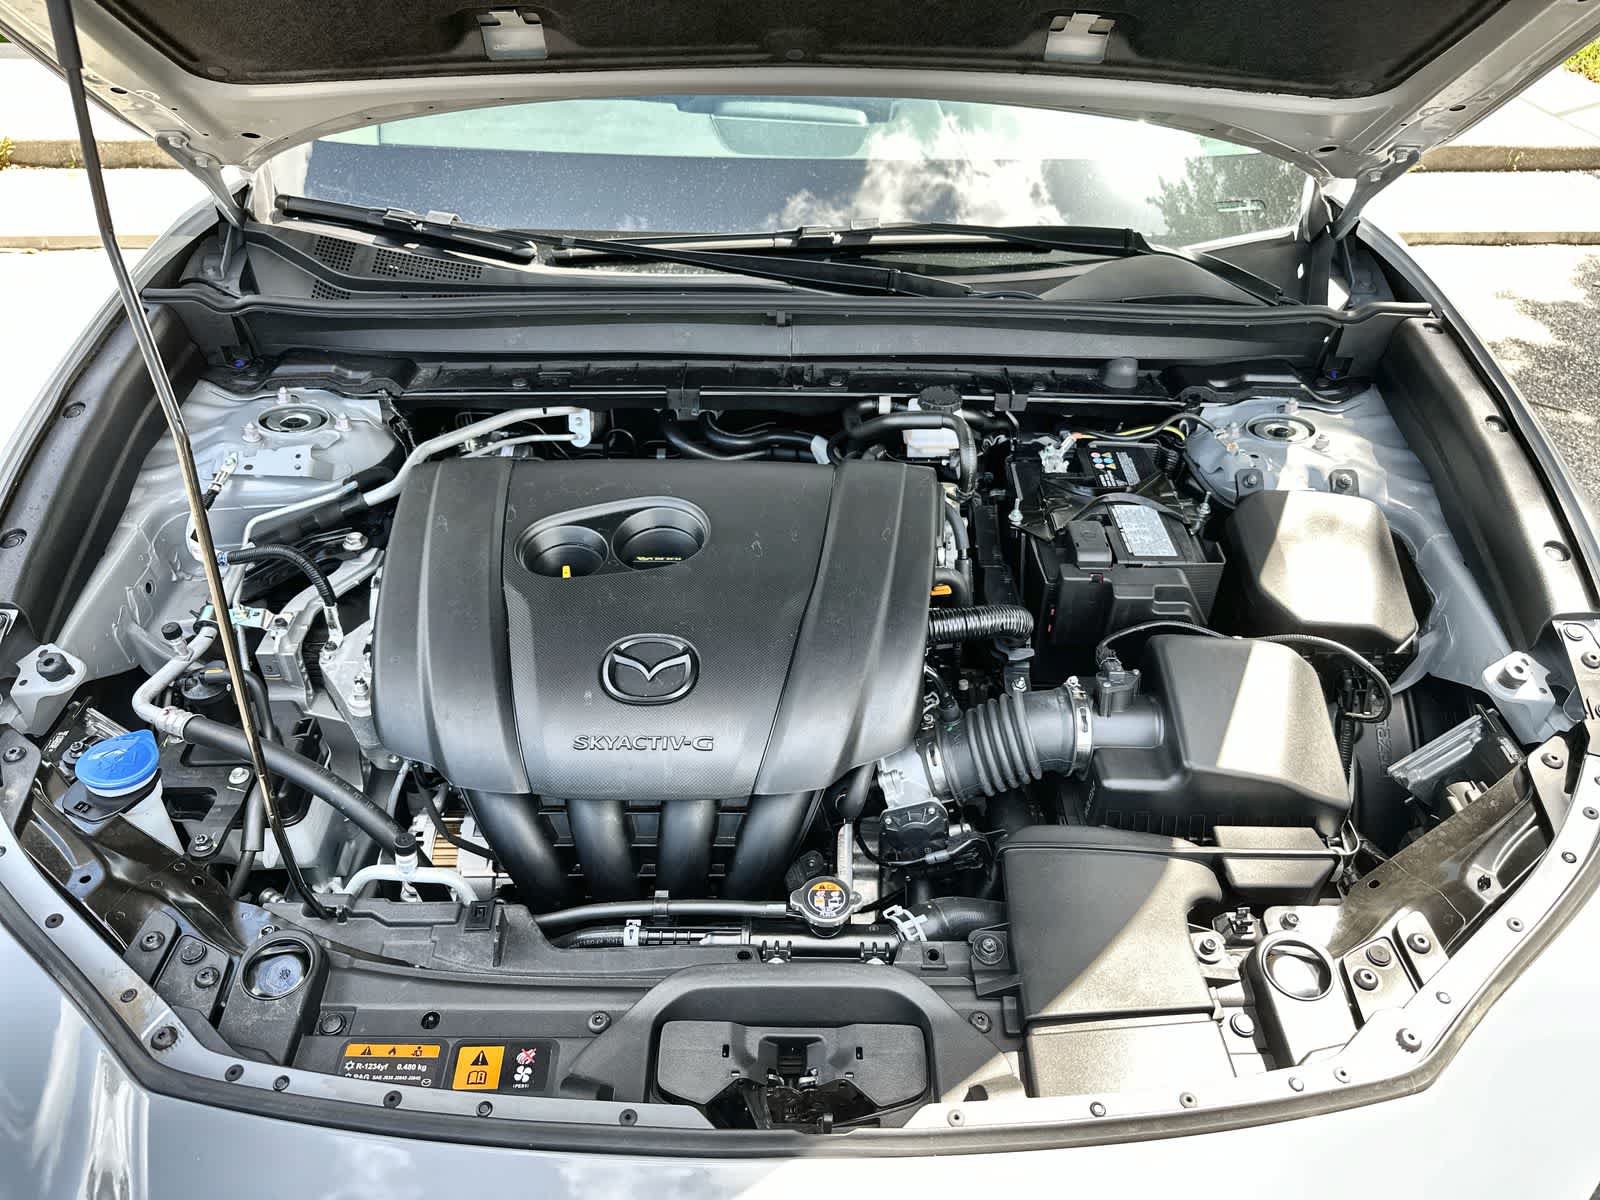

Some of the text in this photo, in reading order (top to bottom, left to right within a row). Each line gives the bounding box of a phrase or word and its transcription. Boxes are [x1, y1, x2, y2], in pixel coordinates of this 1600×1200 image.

[573, 735, 714, 751] SKYACTIV-G
[355, 1063, 389, 1071] R-1234yf
[417, 1063, 427, 1072] kg
